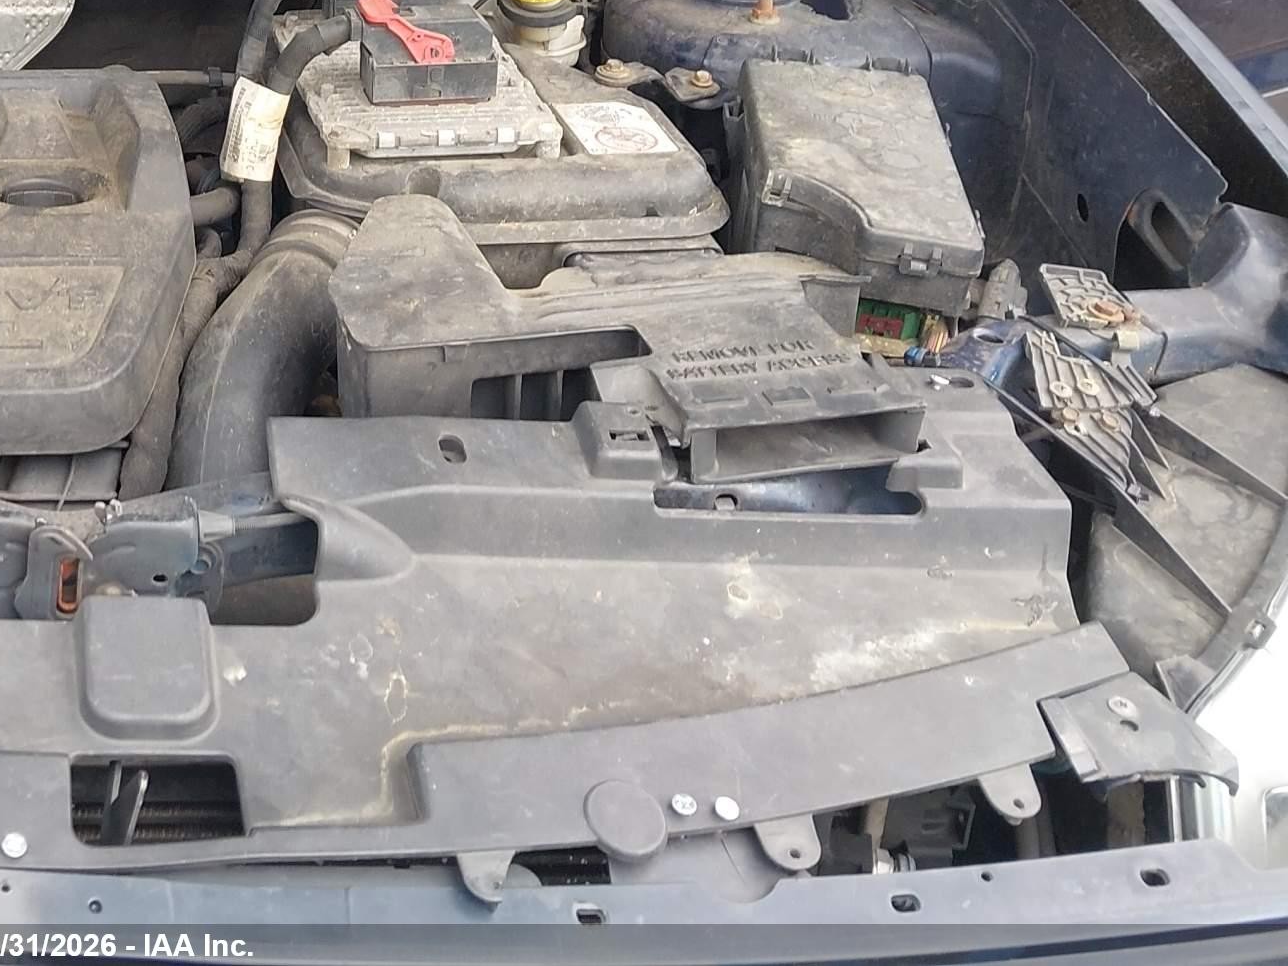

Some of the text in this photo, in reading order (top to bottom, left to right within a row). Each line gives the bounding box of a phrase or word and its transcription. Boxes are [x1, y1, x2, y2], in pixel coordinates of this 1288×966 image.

[671, 338, 816, 363] REMOVE FOR
[665, 352, 852, 380] BATTERY ACCESS
